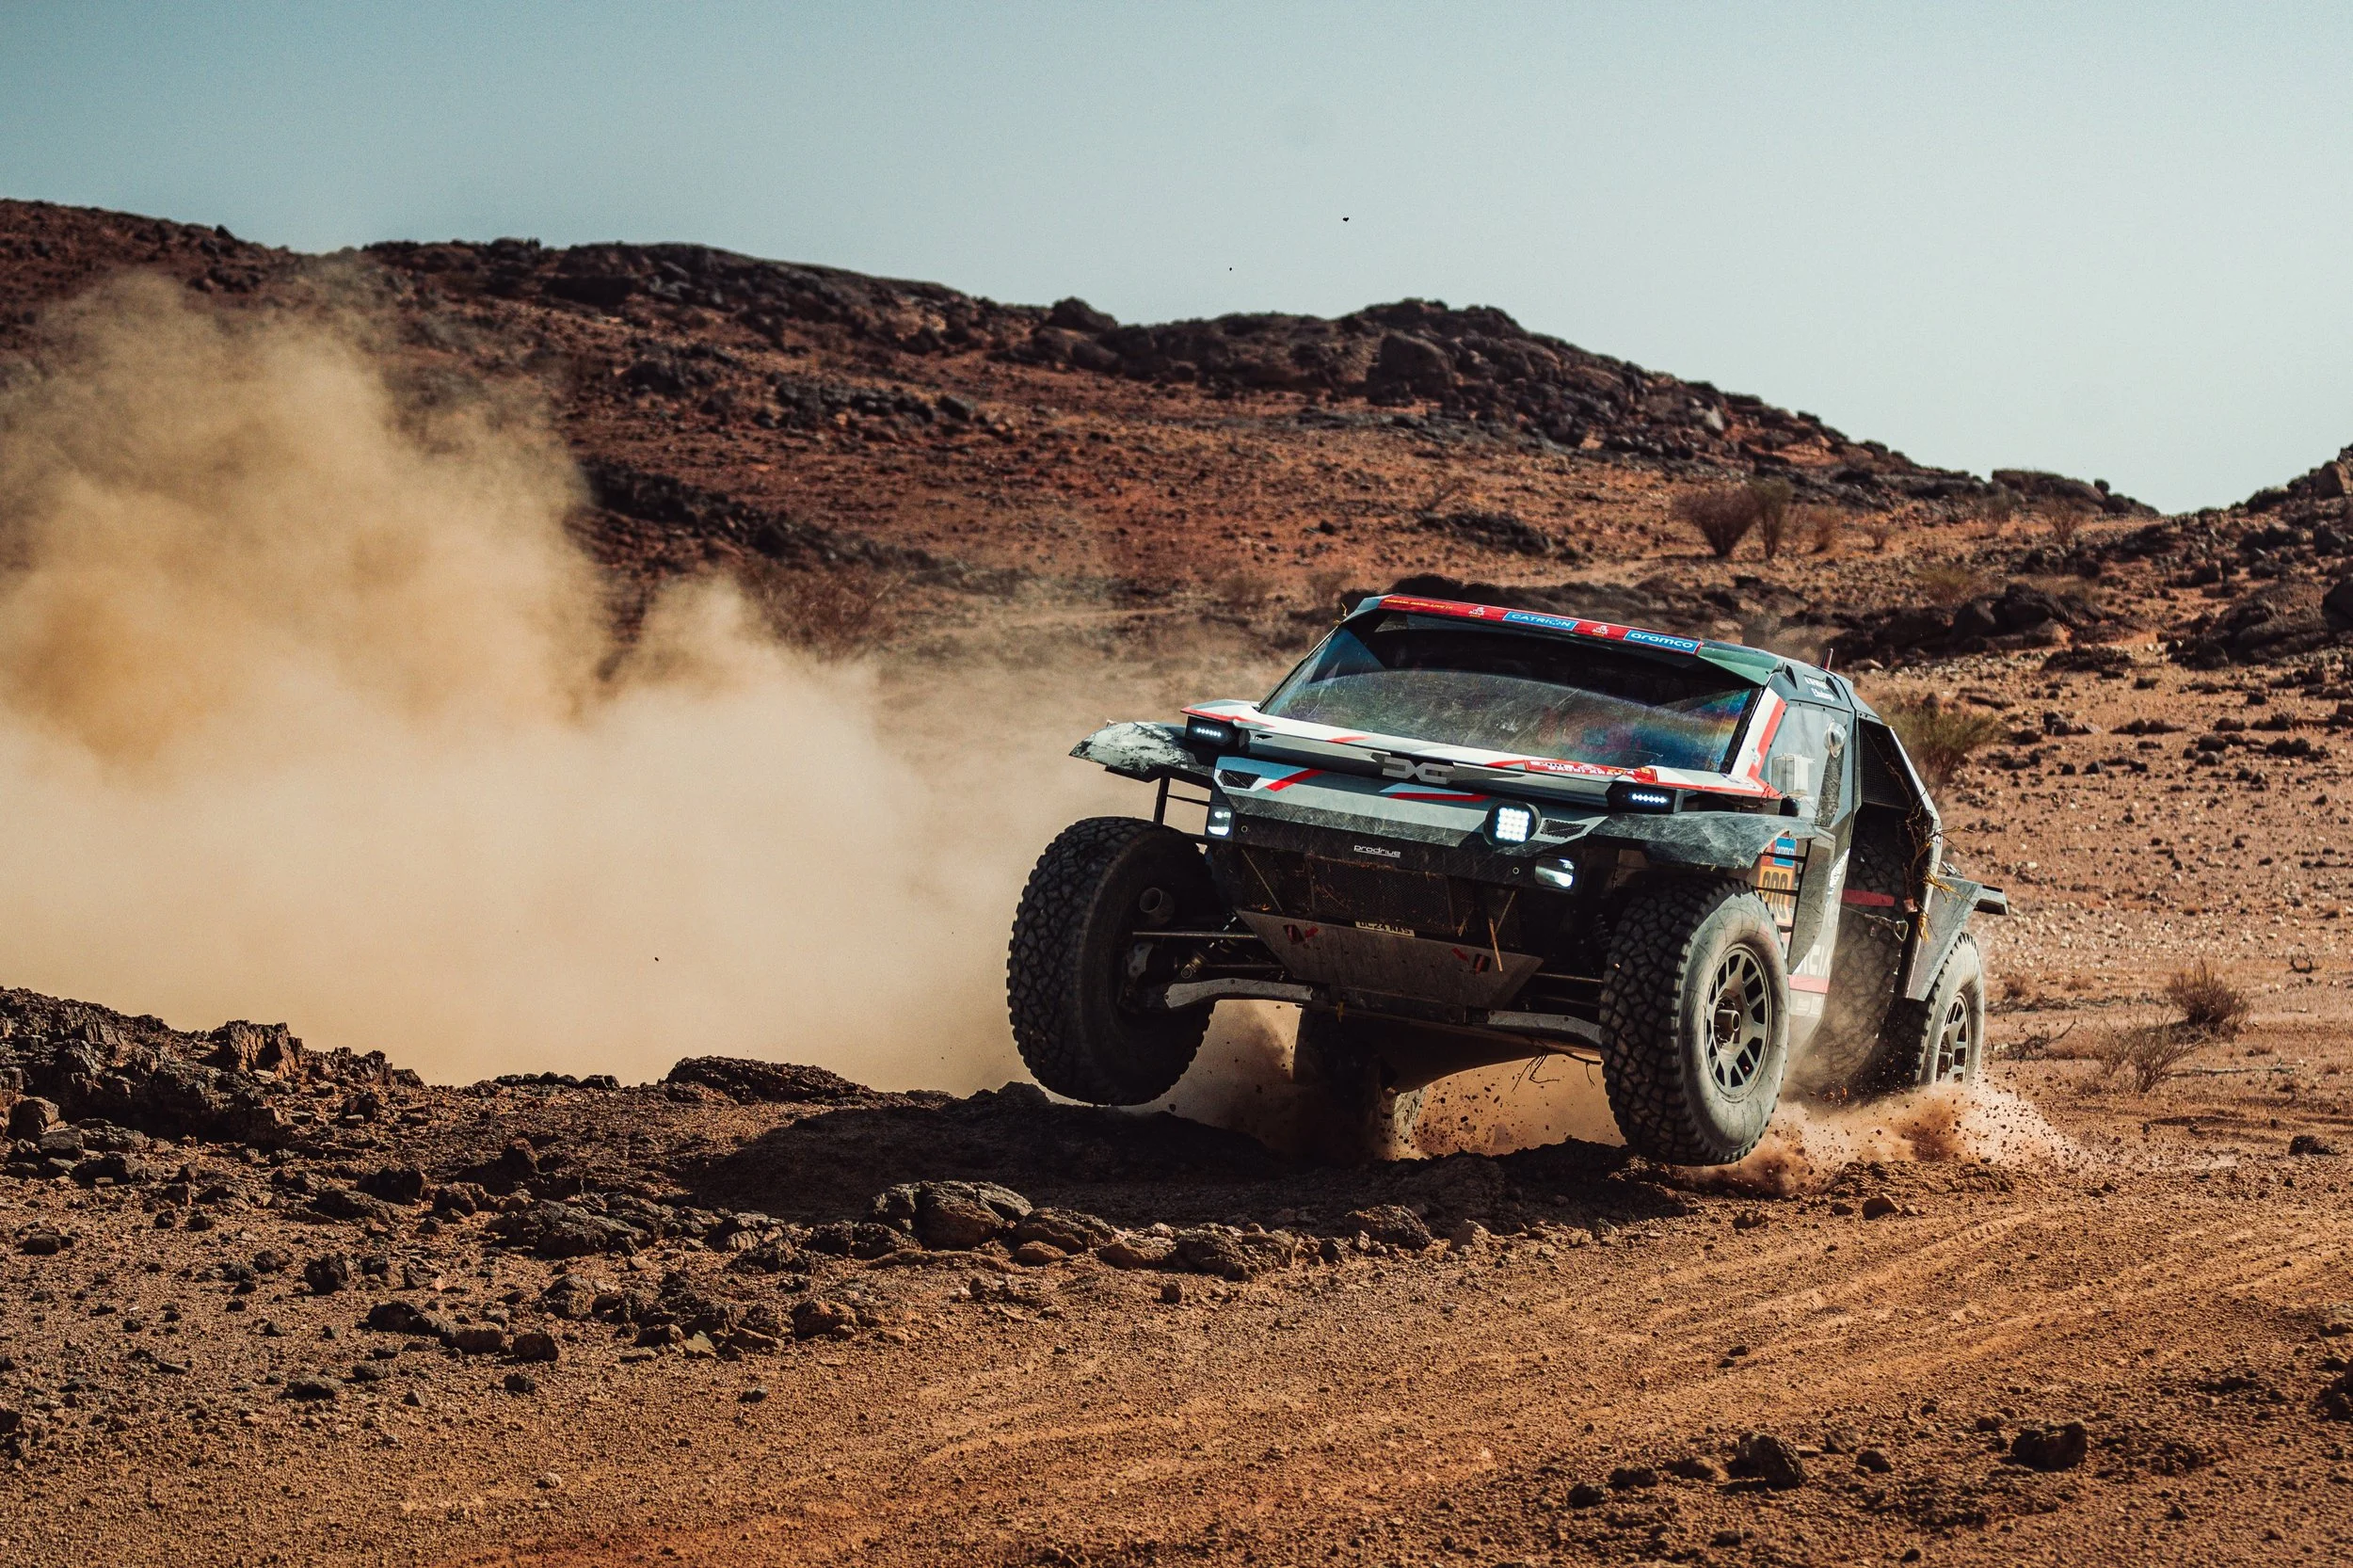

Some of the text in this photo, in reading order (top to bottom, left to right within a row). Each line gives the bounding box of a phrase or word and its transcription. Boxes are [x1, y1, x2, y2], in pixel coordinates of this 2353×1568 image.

[1512, 614, 1571, 627] CATRION
[1630, 632, 1694, 649] aramco
[1353, 844, 1401, 858] prodrive
